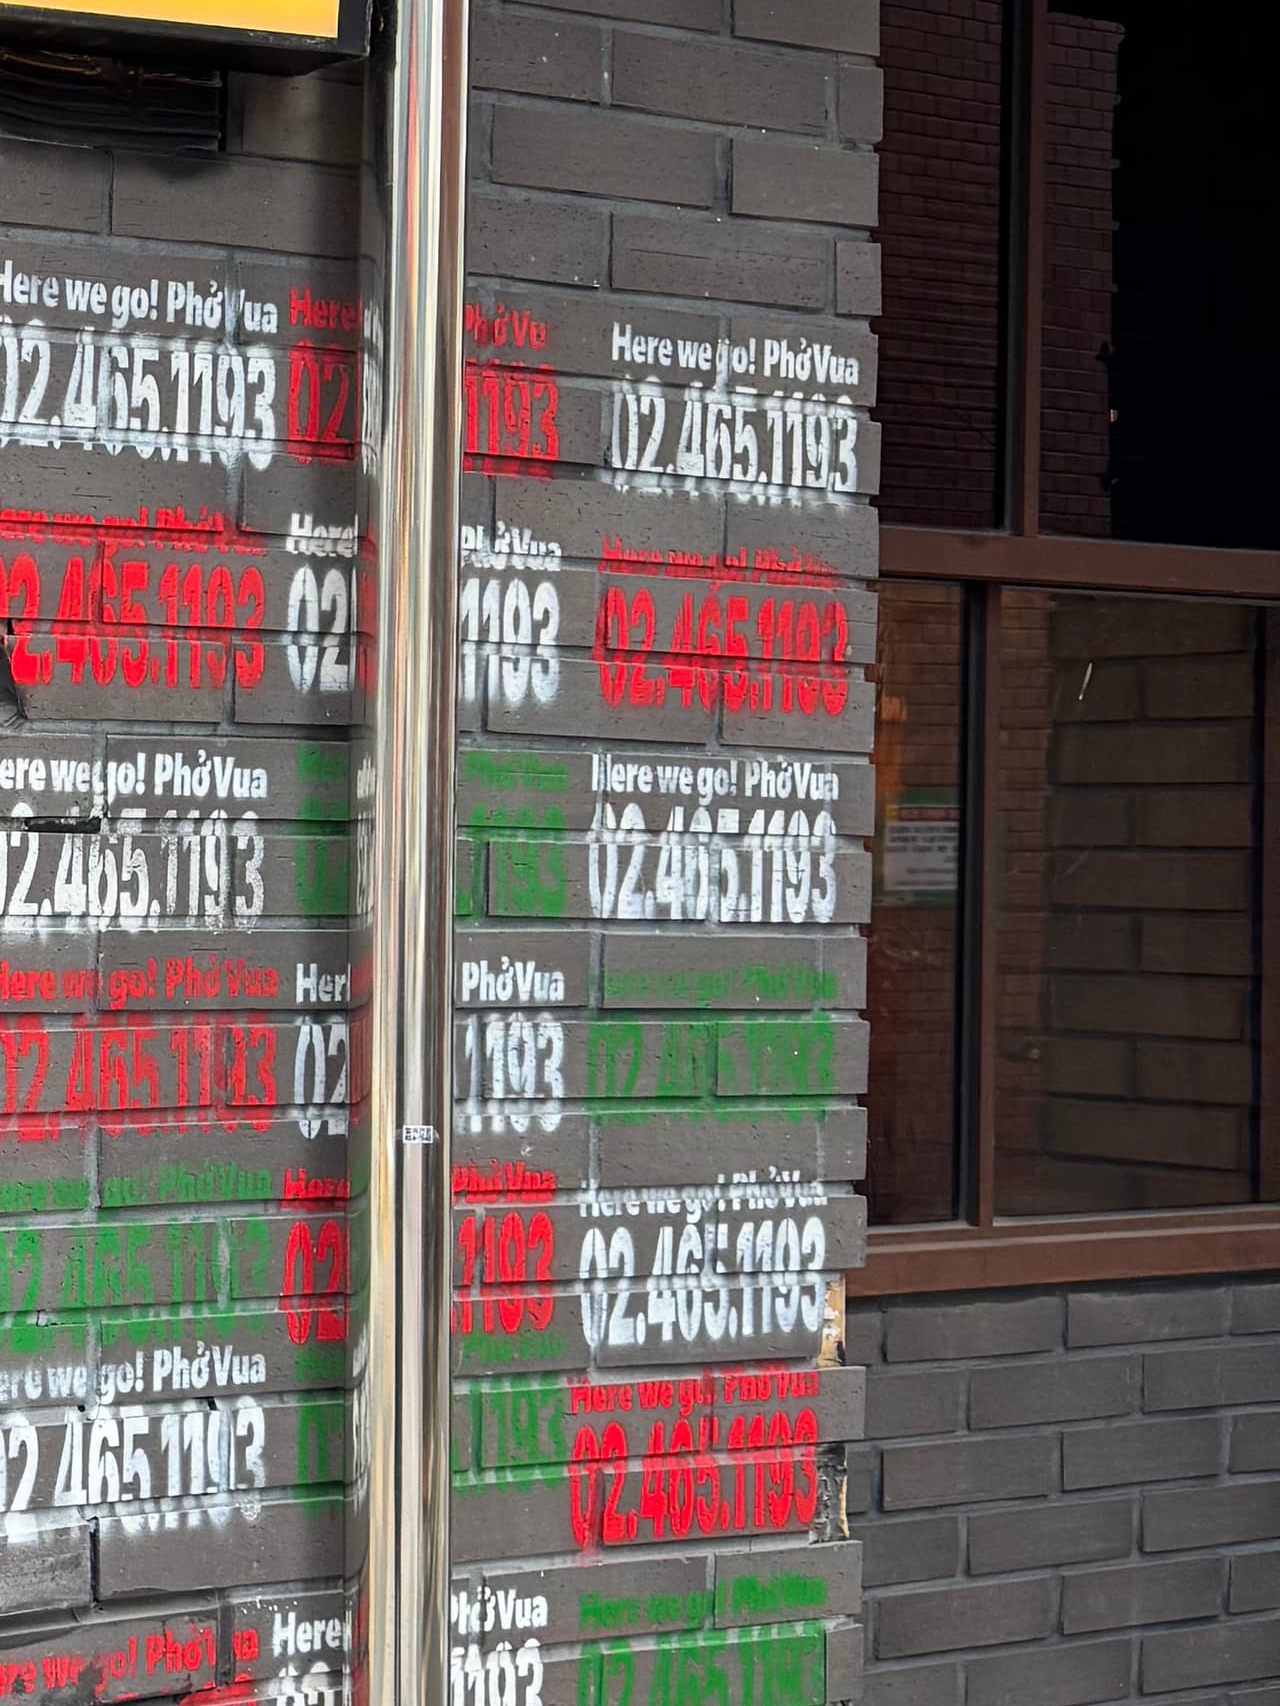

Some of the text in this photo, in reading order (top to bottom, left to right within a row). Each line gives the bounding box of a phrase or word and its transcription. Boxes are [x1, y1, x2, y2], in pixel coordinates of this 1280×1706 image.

[64, 278, 107, 315] we
[112, 279, 159, 329] go!
[612, 321, 673, 367] Here
[677, 339, 711, 370] we
[611, 374, 858, 506] 02.465.1193
[51, 758, 92, 791] we
[591, 753, 652, 793] Here
[657, 763, 692, 793] we
[697, 759, 737, 806] go!
[588, 803, 837, 924] 02.465.1193
[579, 1217, 827, 1347] 02.465.1193
[47, 1357, 87, 1398] we
[569, 1408, 819, 1549] 02.465.1193
